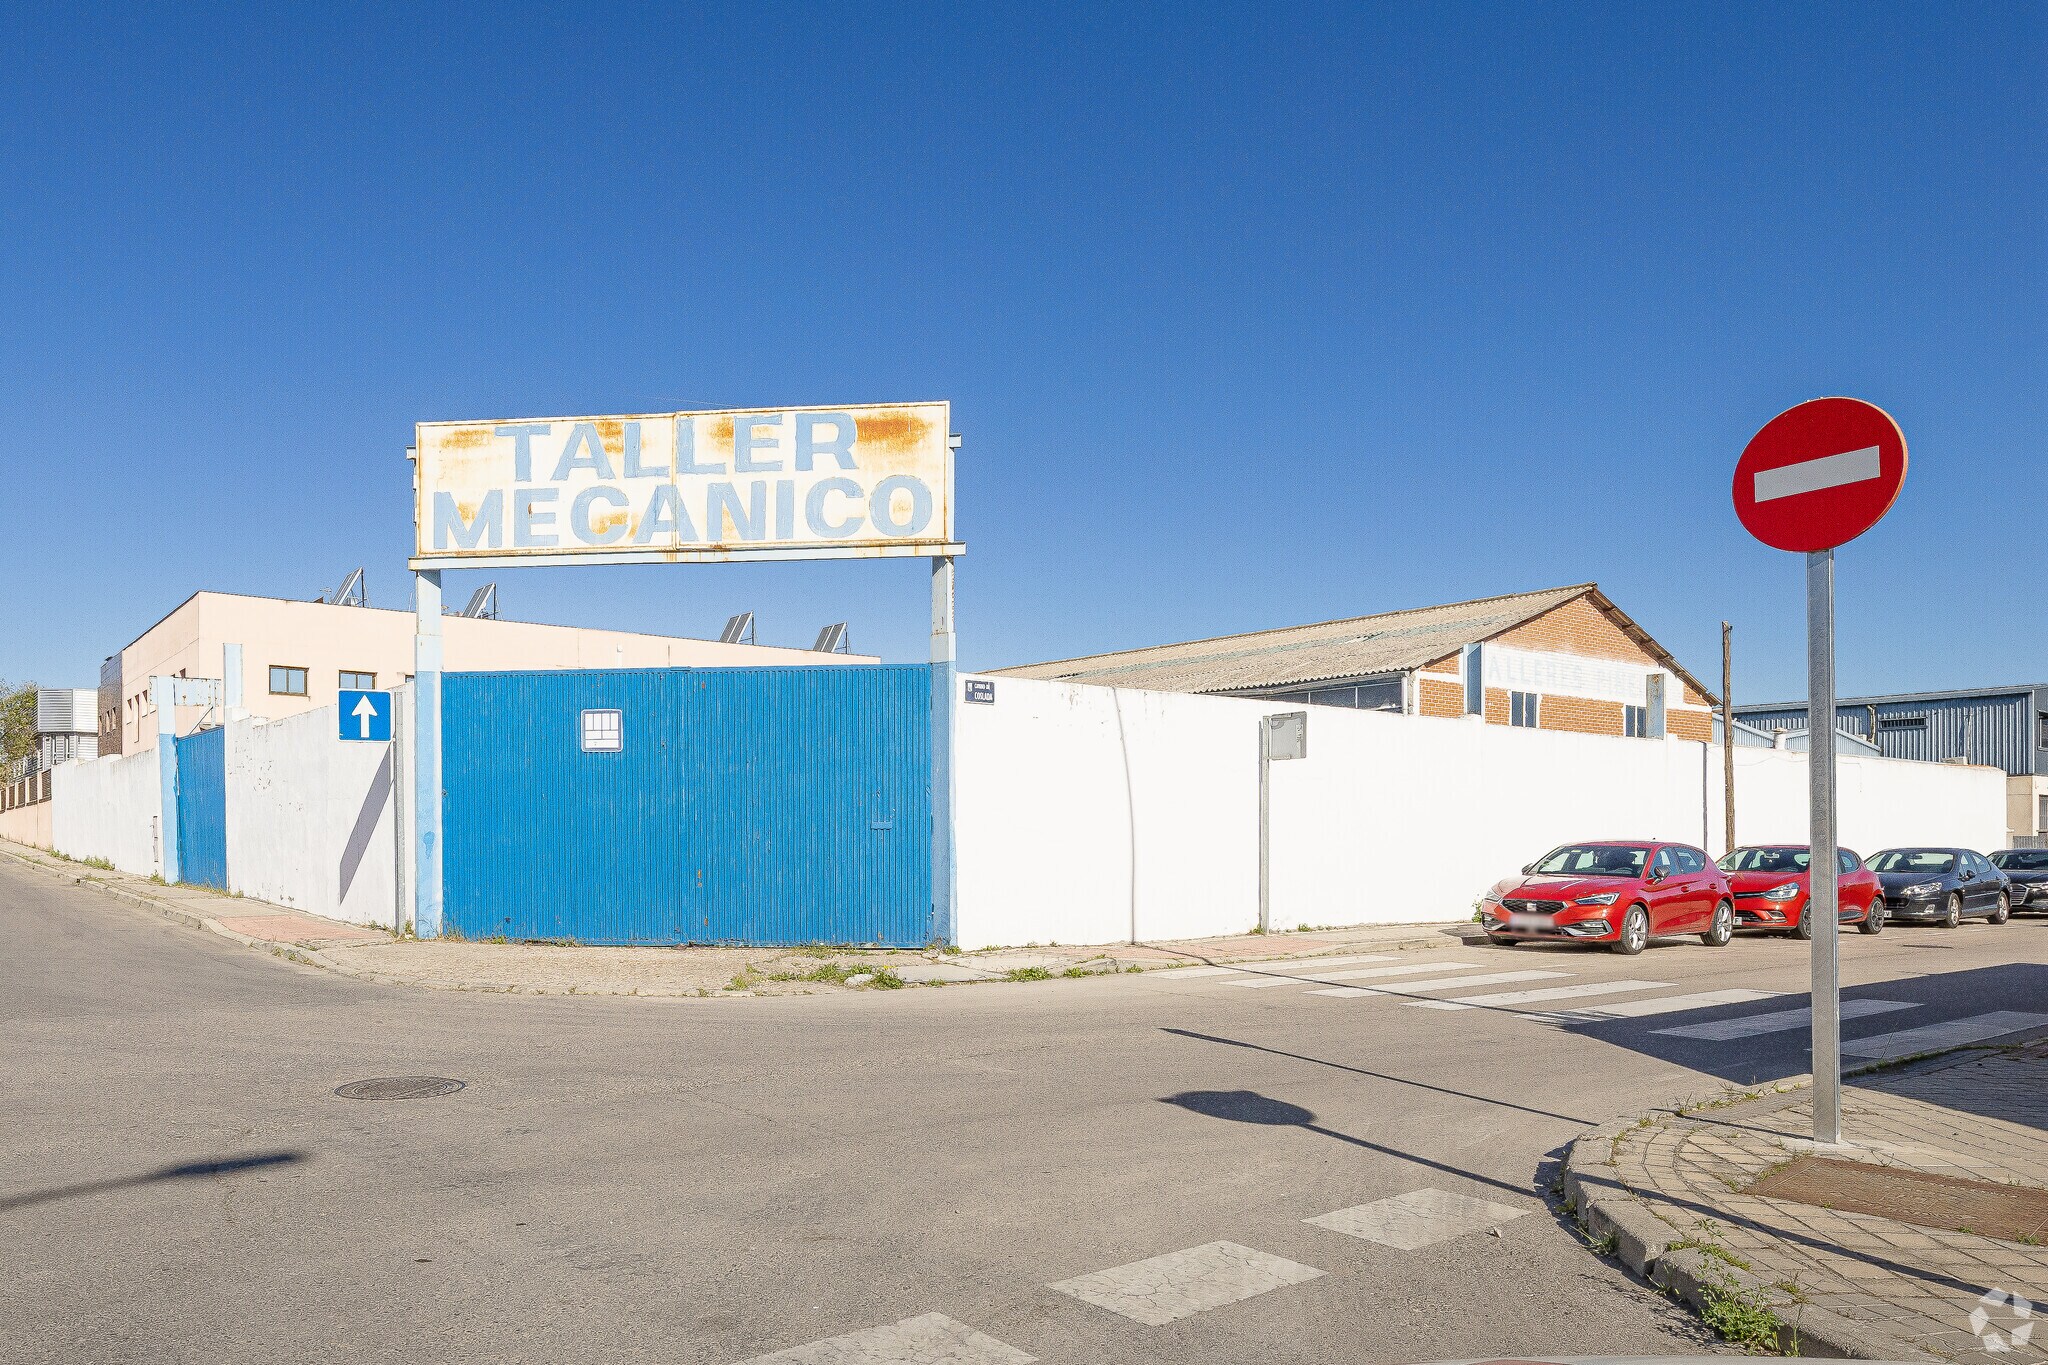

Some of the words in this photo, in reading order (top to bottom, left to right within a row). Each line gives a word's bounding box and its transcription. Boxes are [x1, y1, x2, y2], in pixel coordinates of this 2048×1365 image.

[495, 412, 859, 482] TALLER
[433, 474, 934, 550] MECANICO
[974, 692, 993, 701] COSLADA
